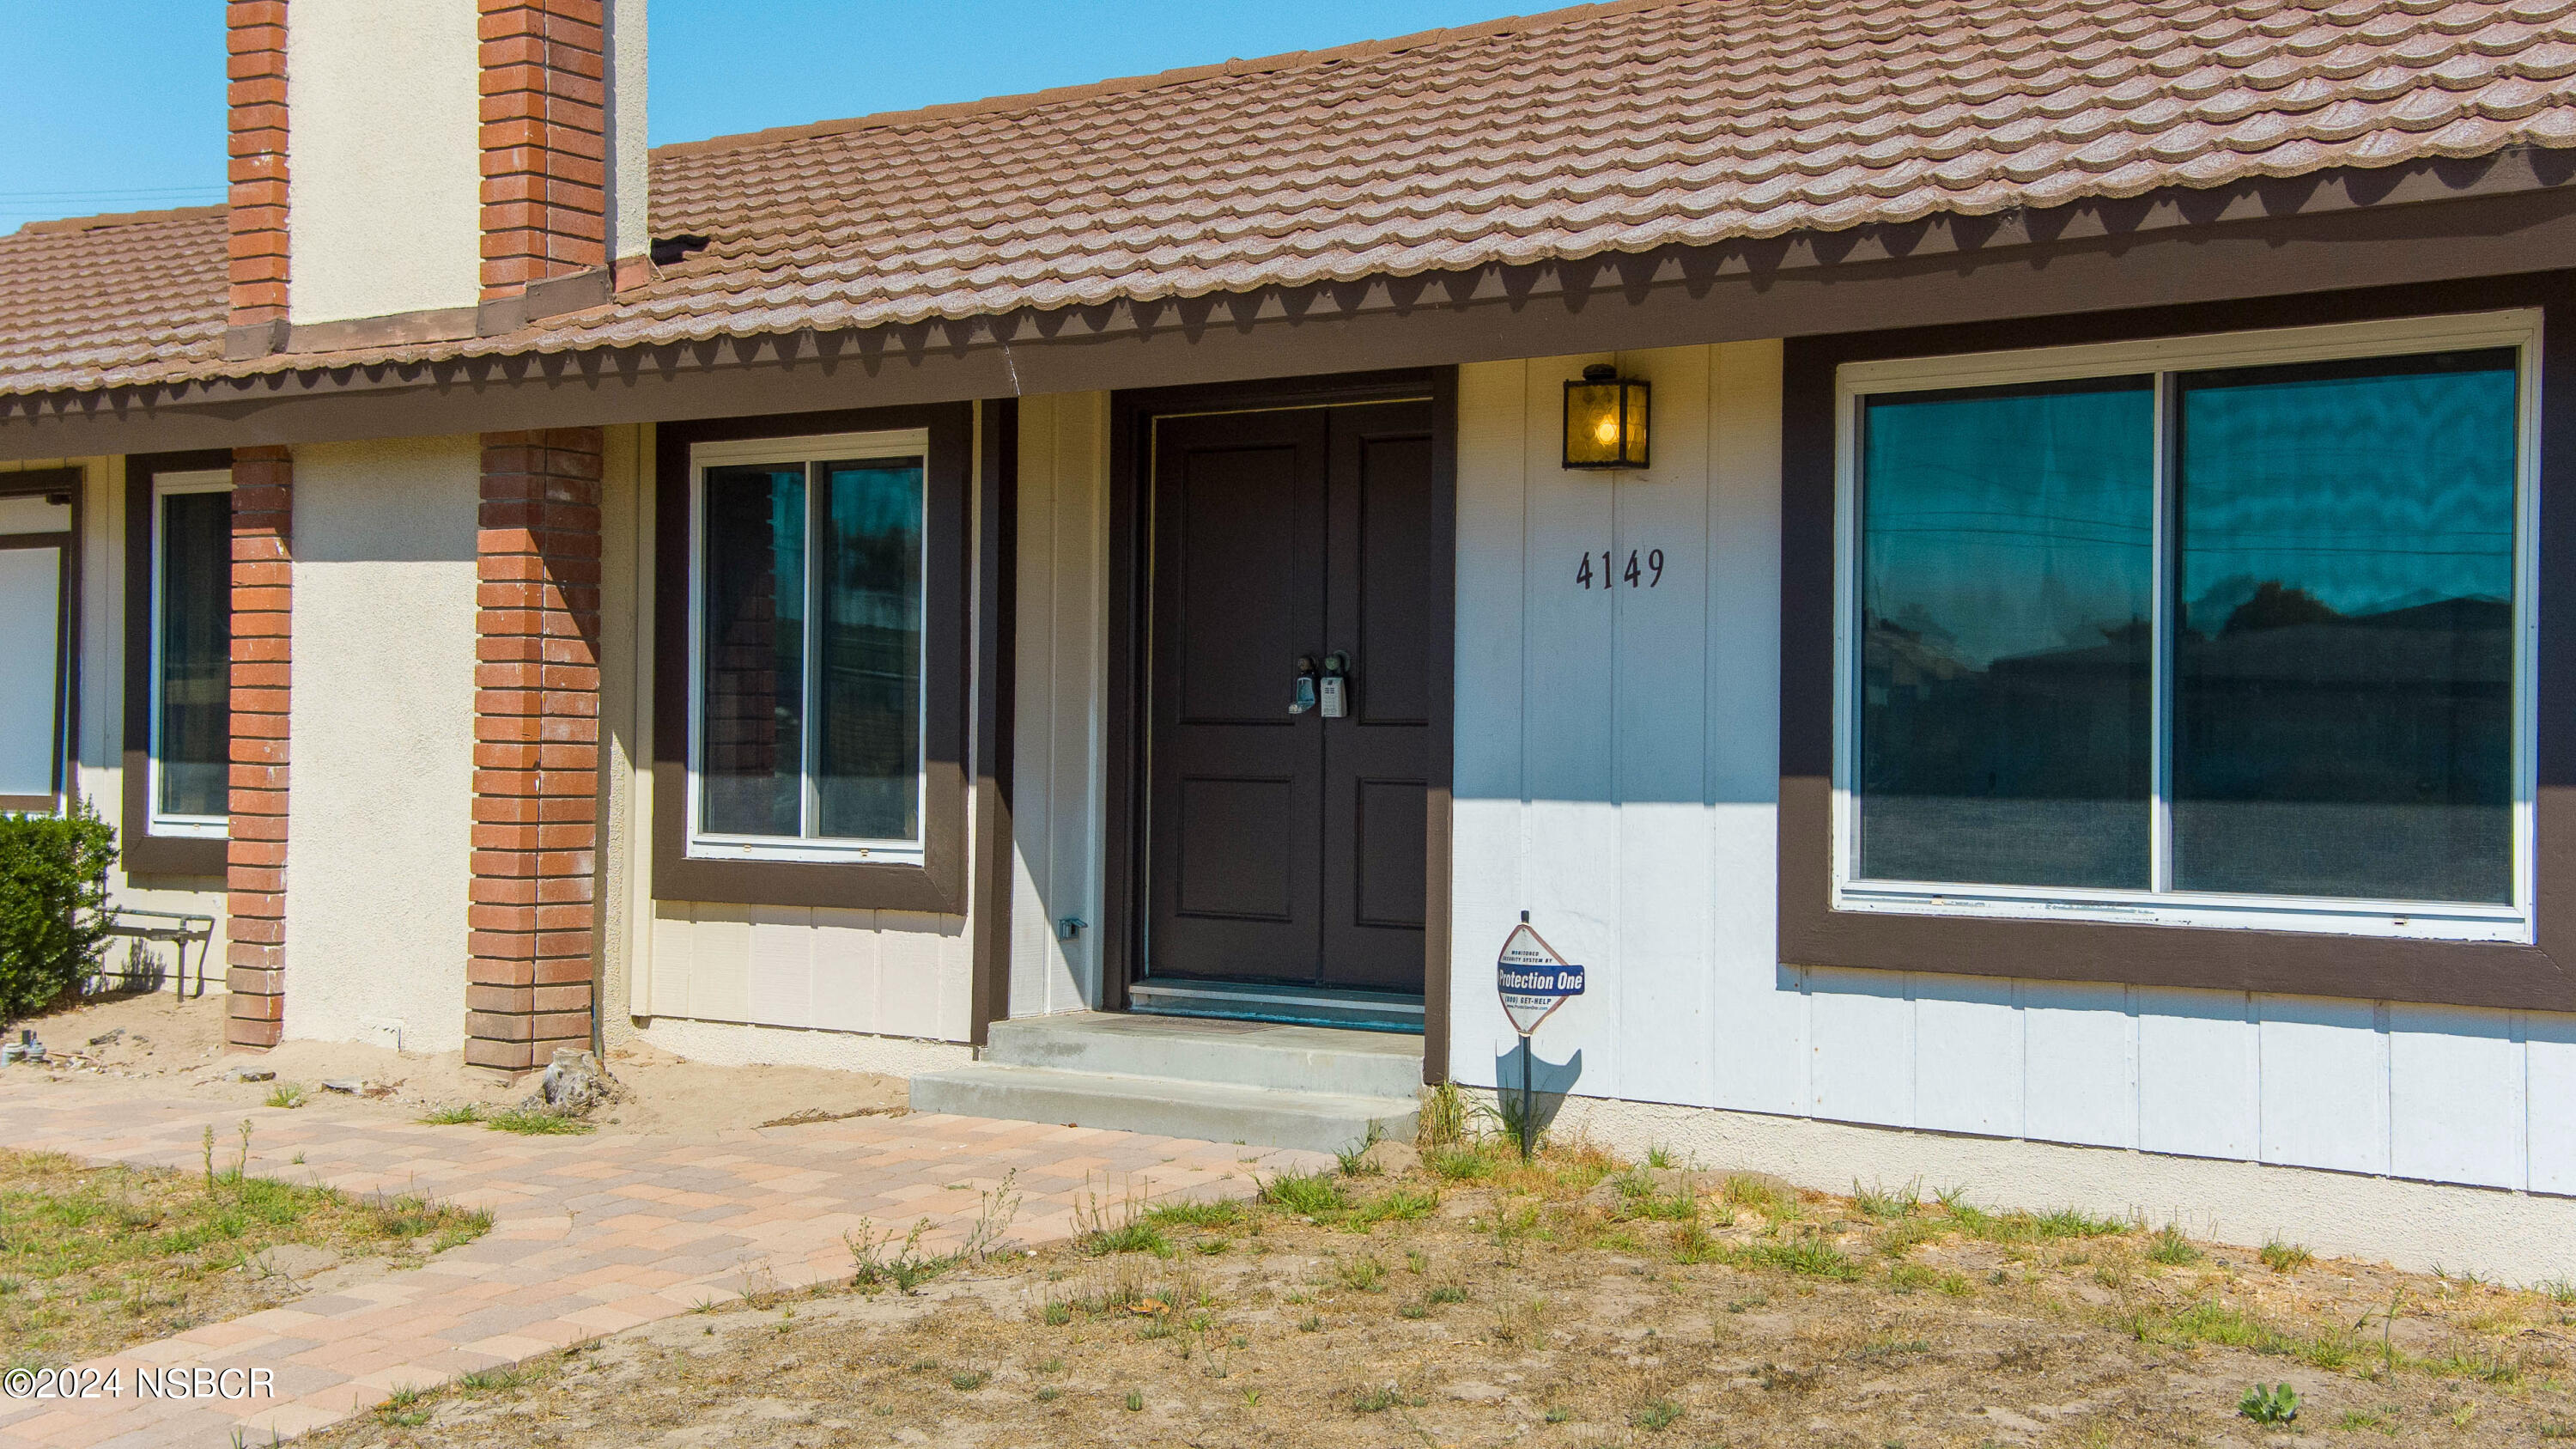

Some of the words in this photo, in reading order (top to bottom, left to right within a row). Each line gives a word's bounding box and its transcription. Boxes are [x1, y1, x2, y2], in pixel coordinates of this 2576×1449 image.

[1576, 549, 1664, 590] 4149
[1498, 968, 1554, 989] Protection
[1558, 971, 1583, 989] One
